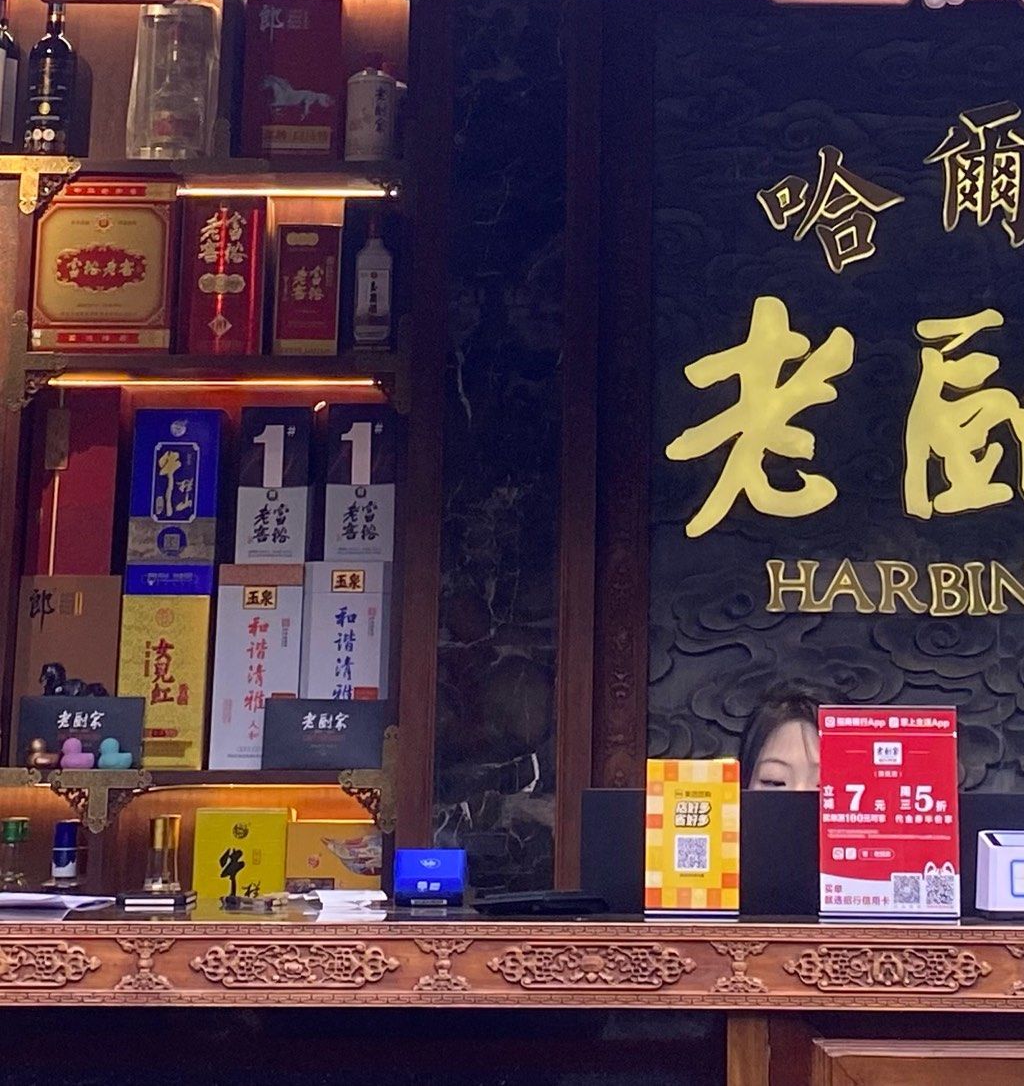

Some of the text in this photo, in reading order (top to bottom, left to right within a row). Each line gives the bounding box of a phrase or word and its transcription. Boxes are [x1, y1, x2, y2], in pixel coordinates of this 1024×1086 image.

[333, 572, 362, 590] 玉泉
[245, 589, 274, 607] 玉泉
[243, 616, 270, 713] 和谐清雅
[844, 783, 866, 812] 7
[914, 784, 934, 813] 5
